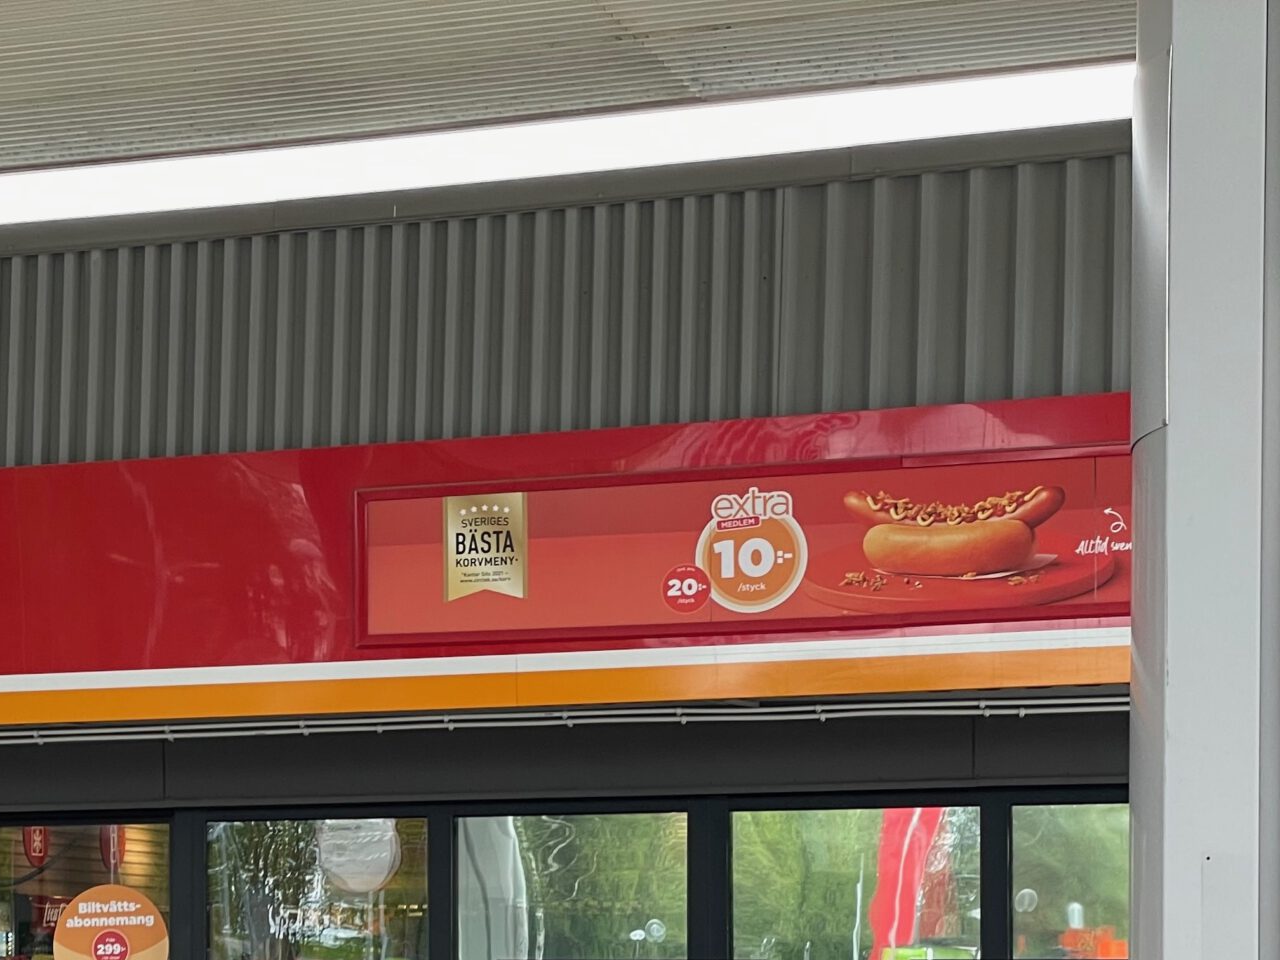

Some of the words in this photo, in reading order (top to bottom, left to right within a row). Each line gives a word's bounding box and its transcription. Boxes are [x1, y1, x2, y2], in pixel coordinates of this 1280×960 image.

[714, 488, 790, 519] extra
[461, 517, 509, 528] SVERIGES
[721, 518, 756, 529] MEDLEM
[456, 529, 515, 555] BÄSTA
[713, 537, 793, 579] 10:-
[667, 577, 707, 597] 20:-
[737, 582, 766, 593] /styck
[78, 900, 141, 915] Biltvätts-
[66, 914, 155, 928] abonnemang
